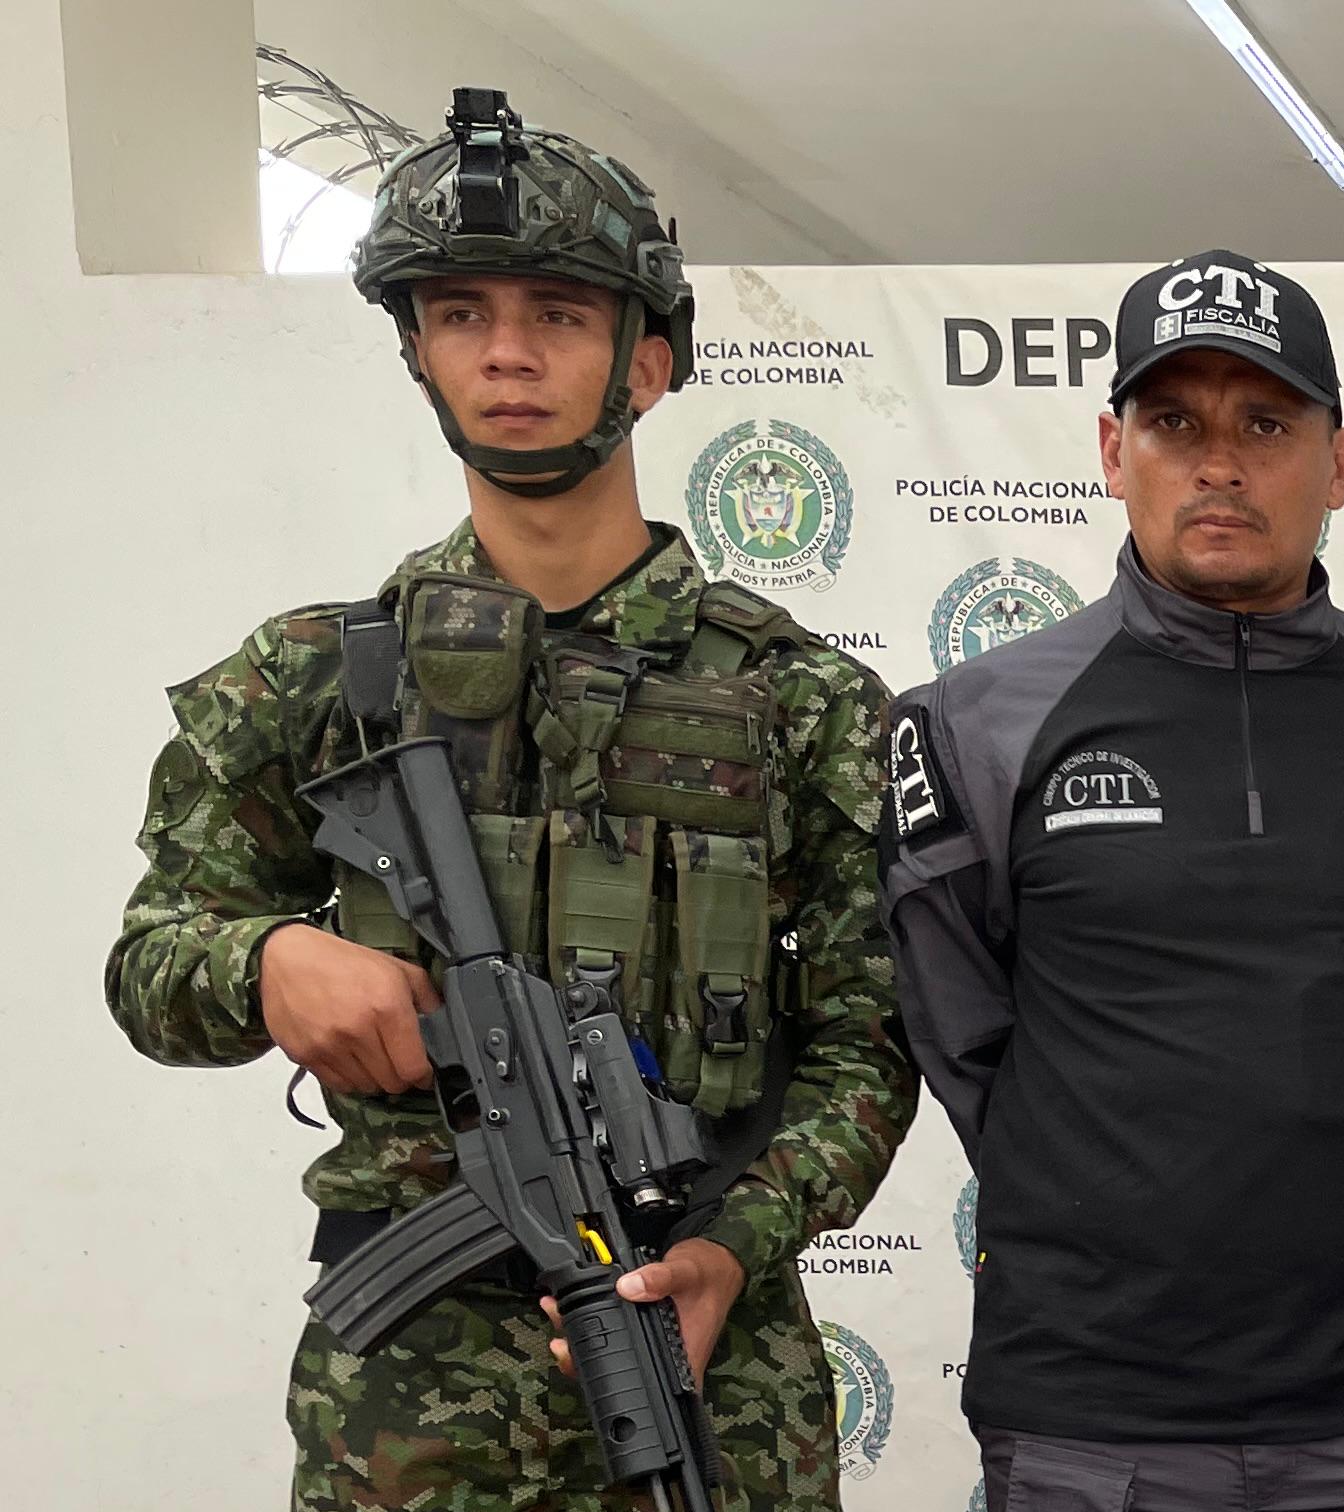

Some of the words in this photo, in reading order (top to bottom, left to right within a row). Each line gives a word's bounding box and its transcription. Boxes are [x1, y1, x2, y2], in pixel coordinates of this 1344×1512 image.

[1158, 264, 1280, 324] CTI
[695, 338, 743, 359] ICÍA
[749, 341, 874, 359] NACIONAL
[720, 368, 844, 386] COLOMBIA
[708, 446, 746, 517] REPUBLICA
[756, 439, 775, 450] DE
[789, 446, 834, 517] COLOMBIA
[895, 475, 986, 498] POLICÍA
[929, 506, 958, 523] DE
[964, 506, 1088, 525] COLOMBIA
[717, 532, 757, 570] POLICIA
[770, 531, 830, 571] NACIONAL
[770, 568, 816, 588] PATRIA
[951, 584, 992, 653] REPUBLICA
[1000, 577, 1018, 587] DE
[1031, 584, 1065, 619] COLO
[822, 632, 888, 650] ONAL
[896, 716, 940, 832] CTI
[1064, 773, 1135, 807] CTI
[796, 1257, 894, 1275] OLOMBIA
[834, 1344, 874, 1410] COLOMBIA
